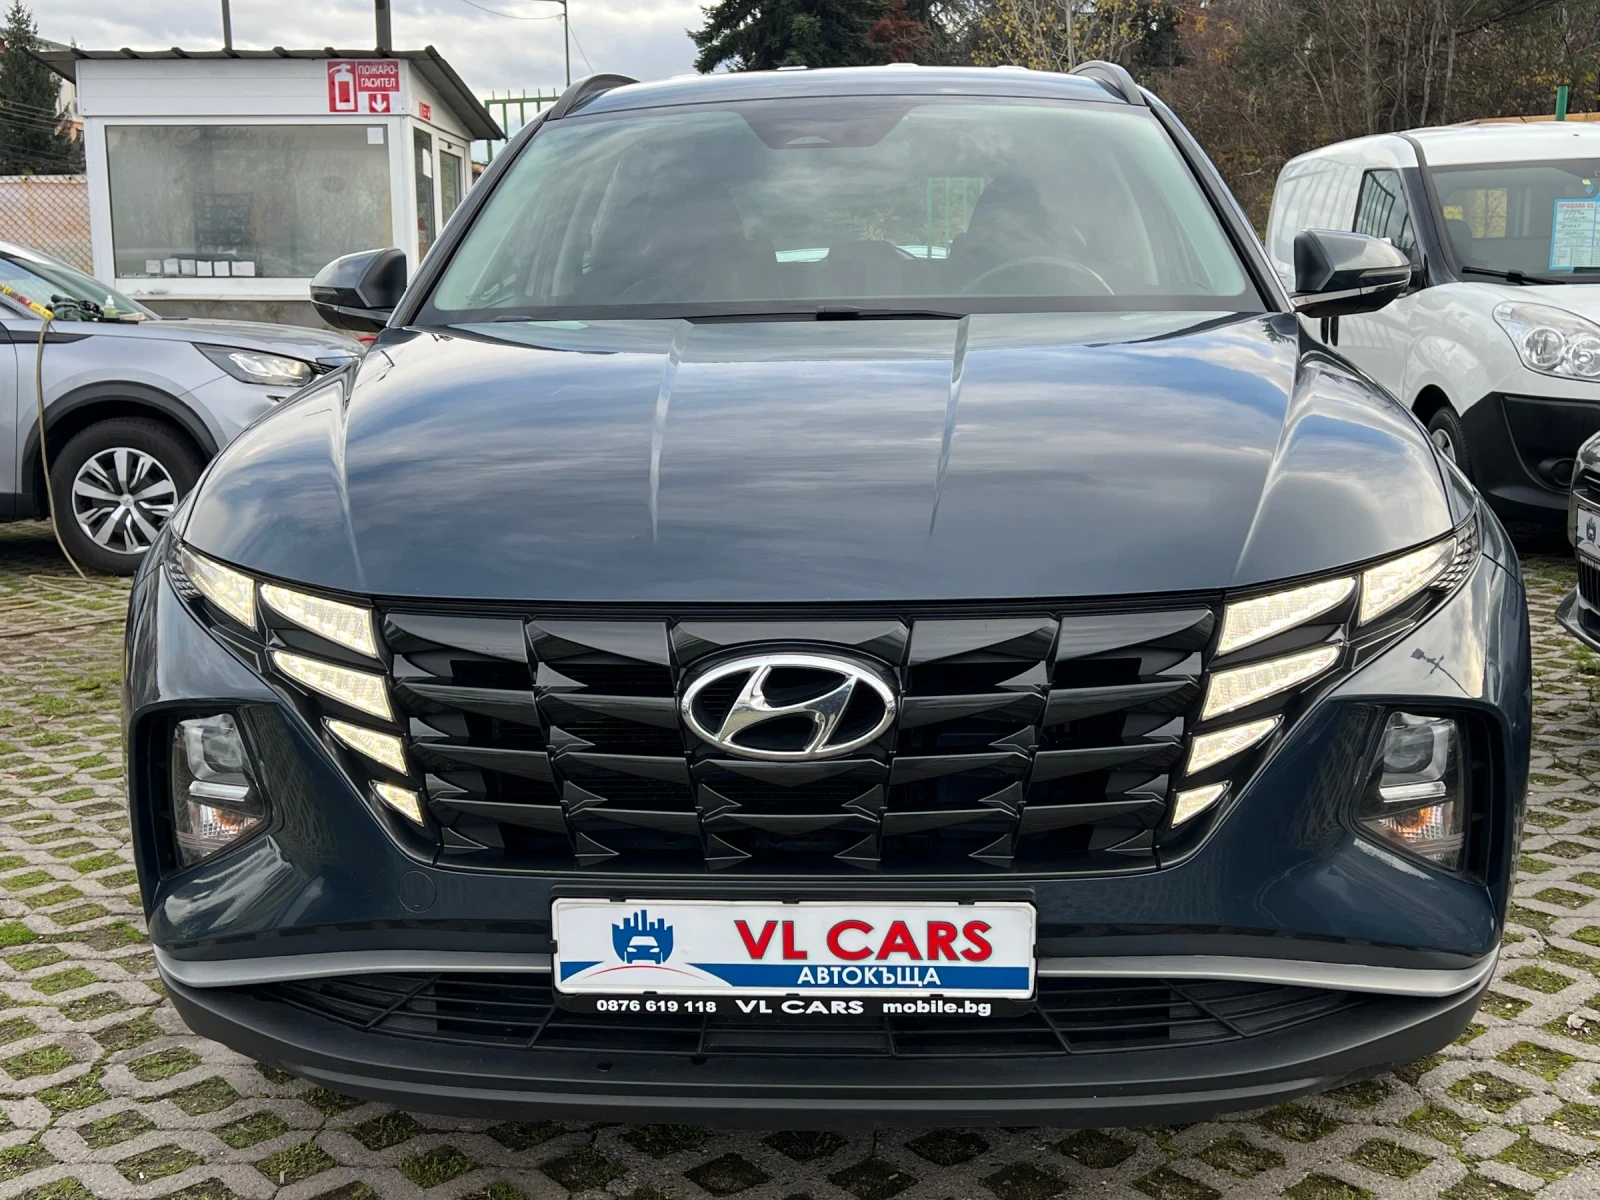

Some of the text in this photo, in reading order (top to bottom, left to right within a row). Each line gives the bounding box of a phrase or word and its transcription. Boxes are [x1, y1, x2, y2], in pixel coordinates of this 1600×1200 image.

[358, 65, 398, 74] ПОЖАРО-
[361, 78, 395, 87] ГАСИТЕЛ
[734, 920, 993, 962] VL CARS
[797, 967, 941, 987] АВТОКЪЩА
[596, 1000, 991, 1017] 0876 619 118 VL CARS mobile.bg
